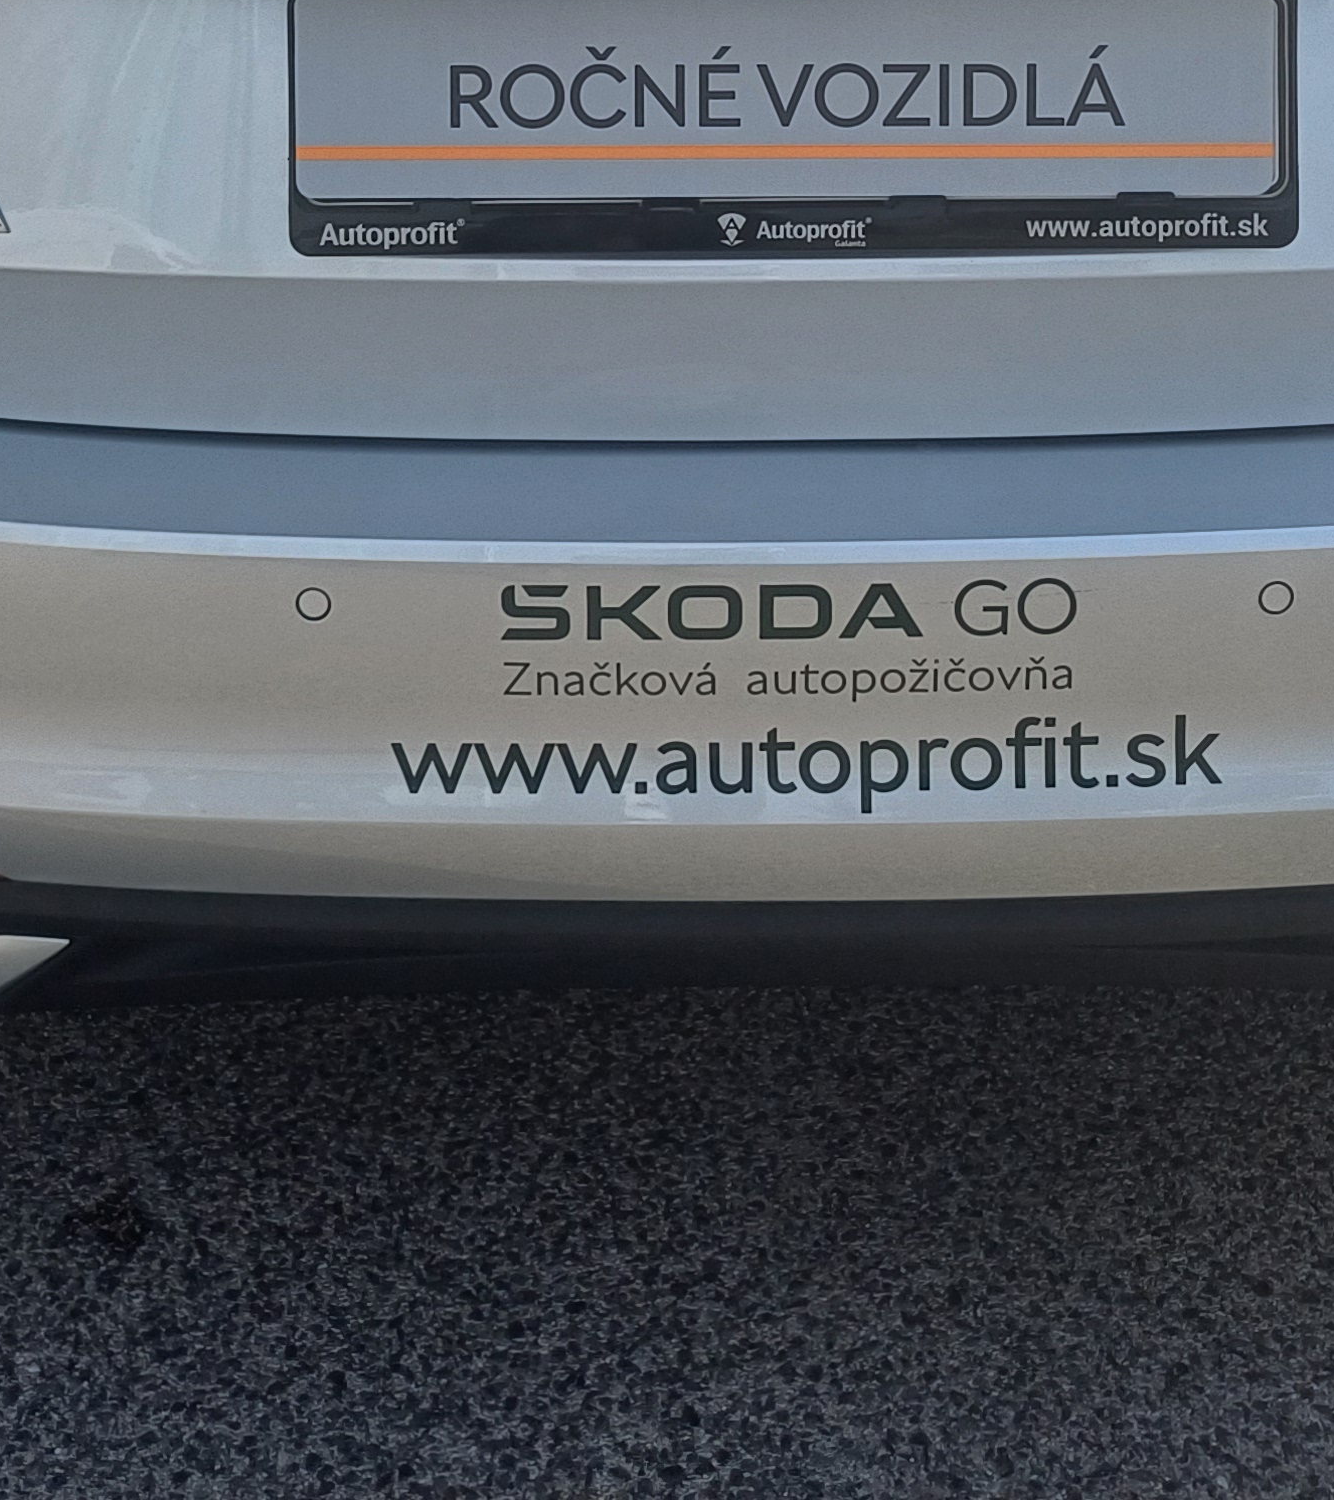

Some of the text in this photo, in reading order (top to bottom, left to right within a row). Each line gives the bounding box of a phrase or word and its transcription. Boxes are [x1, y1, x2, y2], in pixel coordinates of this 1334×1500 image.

[449, 44, 1127, 130] ROČNÉ VOZIDLÁ
[1025, 212, 1270, 243] www.autoprofit.sk
[953, 576, 1078, 637] GO
[502, 655, 1074, 703] Značková autopožičovňa
[390, 714, 1224, 815] www.autoprofit.sk
